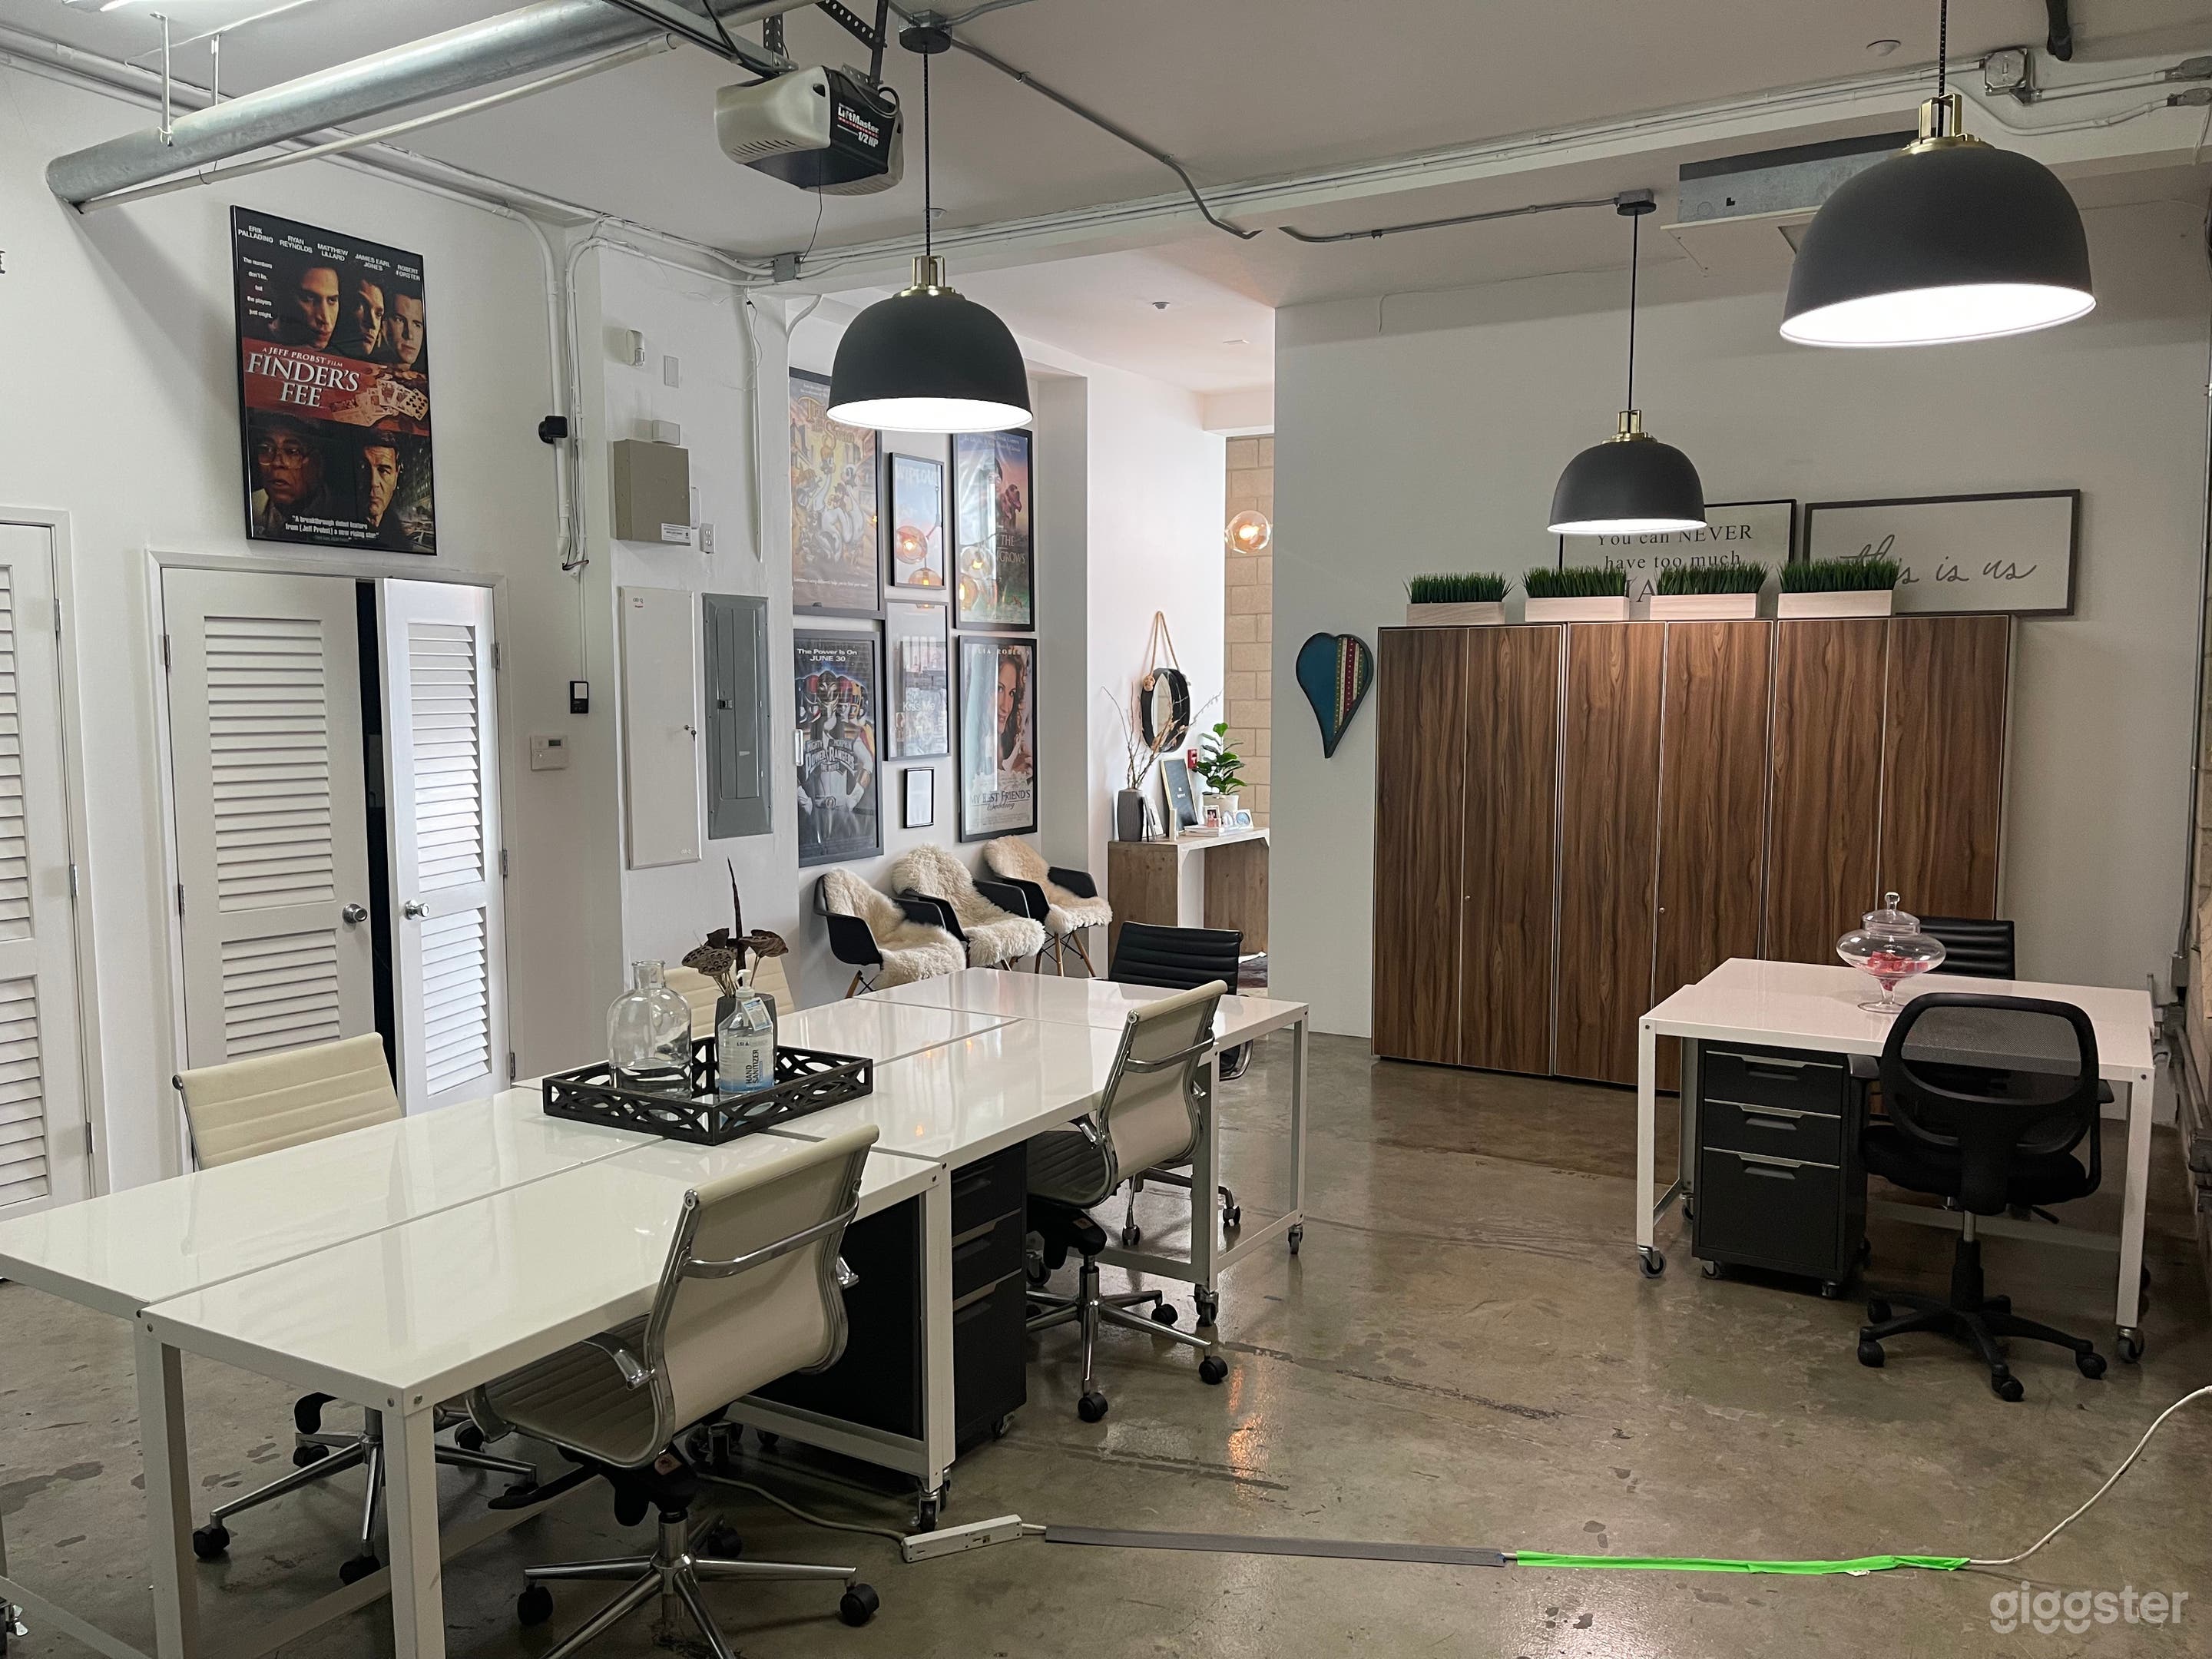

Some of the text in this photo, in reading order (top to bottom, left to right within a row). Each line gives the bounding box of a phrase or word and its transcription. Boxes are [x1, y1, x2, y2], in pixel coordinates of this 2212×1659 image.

[838, 107, 879, 134] LiftMaster
[858, 131, 879, 147] 1/2 HP
[238, 229, 273, 243] PALLADINO
[249, 225, 263, 233] ERIK
[279, 239, 313, 253] REYNOLDS
[287, 235, 304, 245] RYAN
[317, 243, 348, 256] MATTHEW
[321, 250, 345, 261] LILLARD
[355, 253, 390, 267] JAMES EARL
[363, 262, 382, 271] JONES
[396, 270, 420, 281] FORSTER
[398, 264, 419, 274] ROBERT
[269, 346, 289, 356] JEFF
[291, 351, 327, 364] PROBST
[246, 353, 360, 392] FINDER'S
[280, 382, 323, 407] FEE
[1598, 525, 1753, 545] You can NEVER
[1605, 551, 1740, 569] have too much
[1936, 556, 1969, 581] is
[1983, 560, 2037, 580] us
